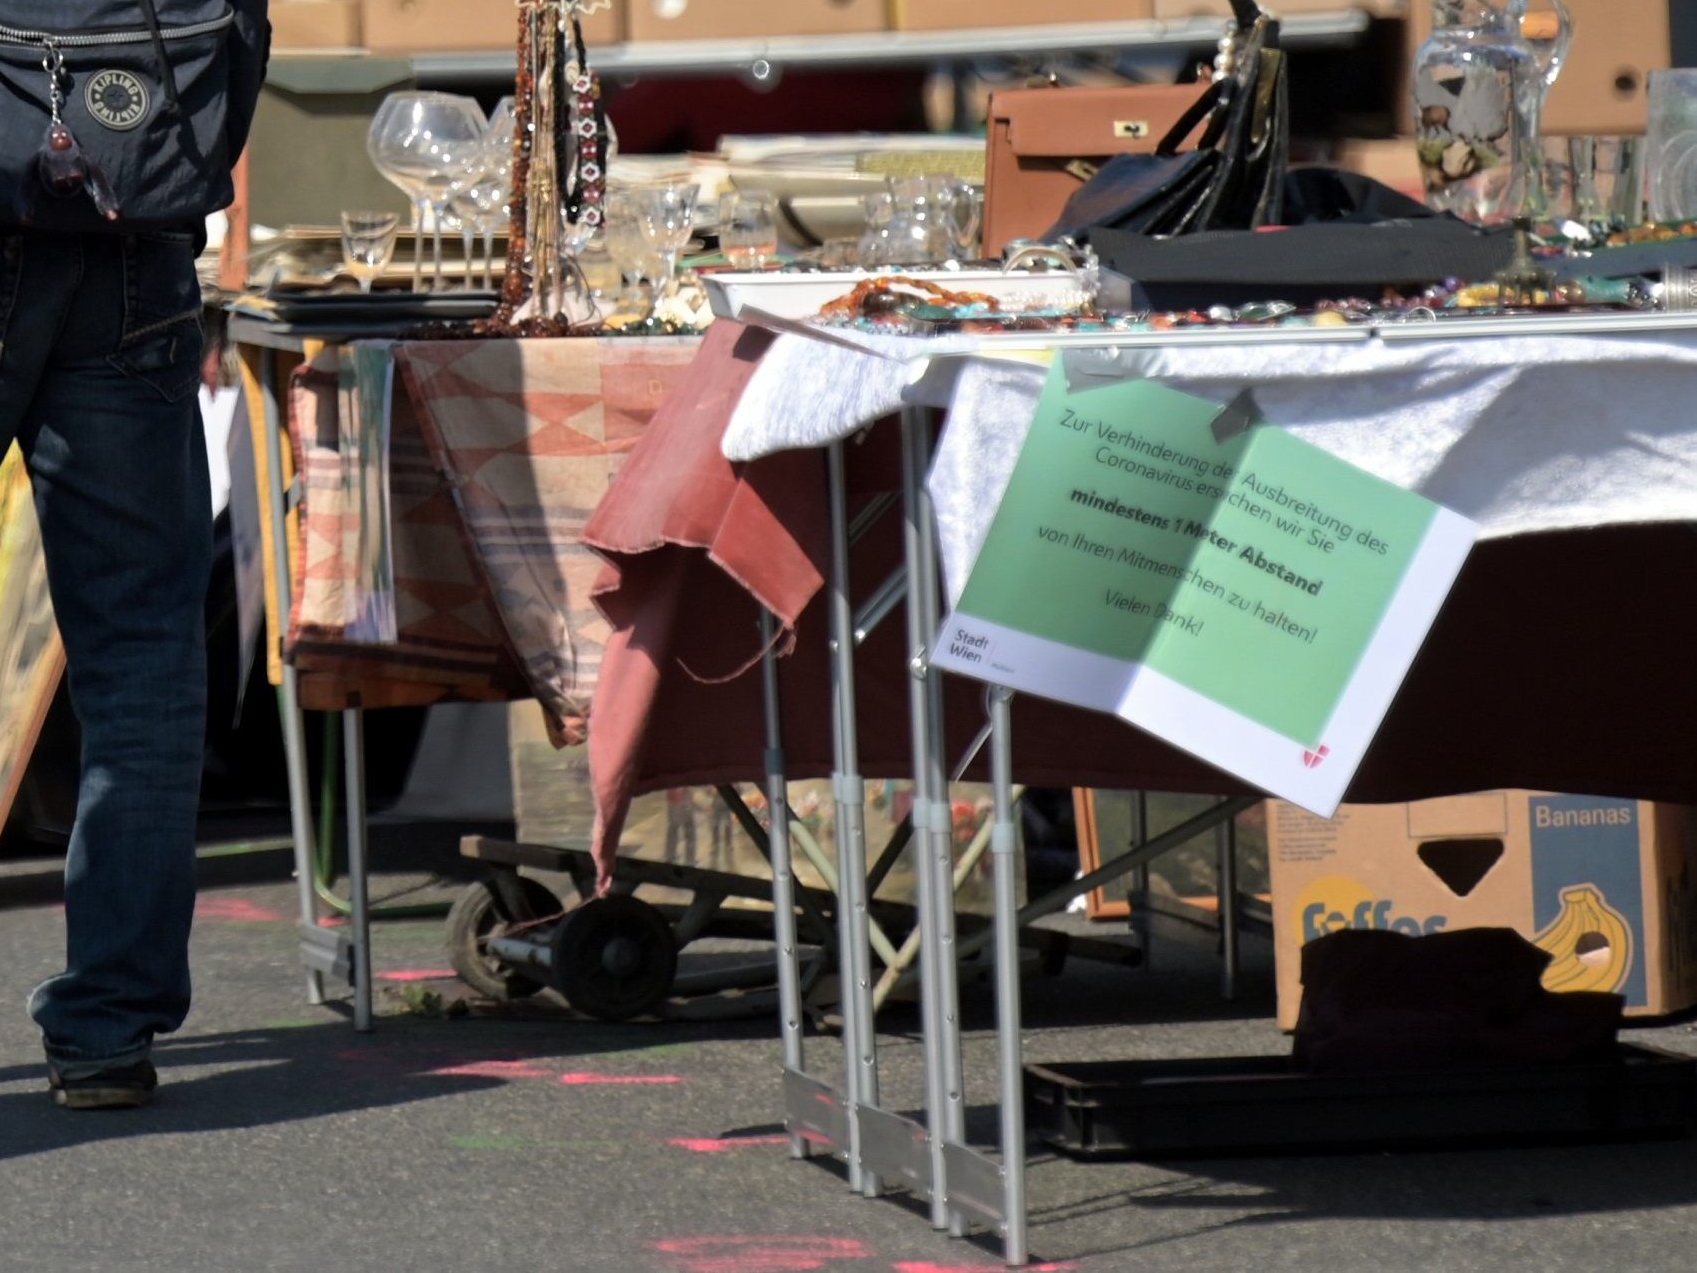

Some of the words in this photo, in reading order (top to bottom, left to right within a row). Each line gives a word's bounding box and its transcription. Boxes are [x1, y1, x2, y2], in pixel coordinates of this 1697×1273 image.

[93, 73, 139, 95] KIPLING
[93, 101, 141, 123] KIPLING
[1060, 408, 1093, 433] Zur
[1098, 421, 1210, 477] Verhinderung
[1241, 473, 1353, 542] Ausbreitung
[1356, 530, 1390, 557] des
[1095, 446, 1194, 492] Coronavirus
[1276, 516, 1305, 538] wir
[1306, 528, 1335, 555] Sie
[1070, 488, 1171, 530] mindestens
[1174, 518, 1182, 534] 1
[1182, 520, 1239, 554] Meter
[1239, 546, 1323, 597] Abstand
[1037, 526, 1070, 547] von
[1072, 533, 1115, 560] Ihren
[1117, 548, 1226, 600] Mitmenschen
[1228, 591, 1251, 612] zu
[1253, 600, 1319, 645] halten!
[1104, 588, 1151, 617] Vielen
[1153, 602, 1205, 637] Dank!
[950, 643, 983, 664] Wien
[955, 629, 989, 650] Stadt
[1535, 805, 1631, 828] Bananas
